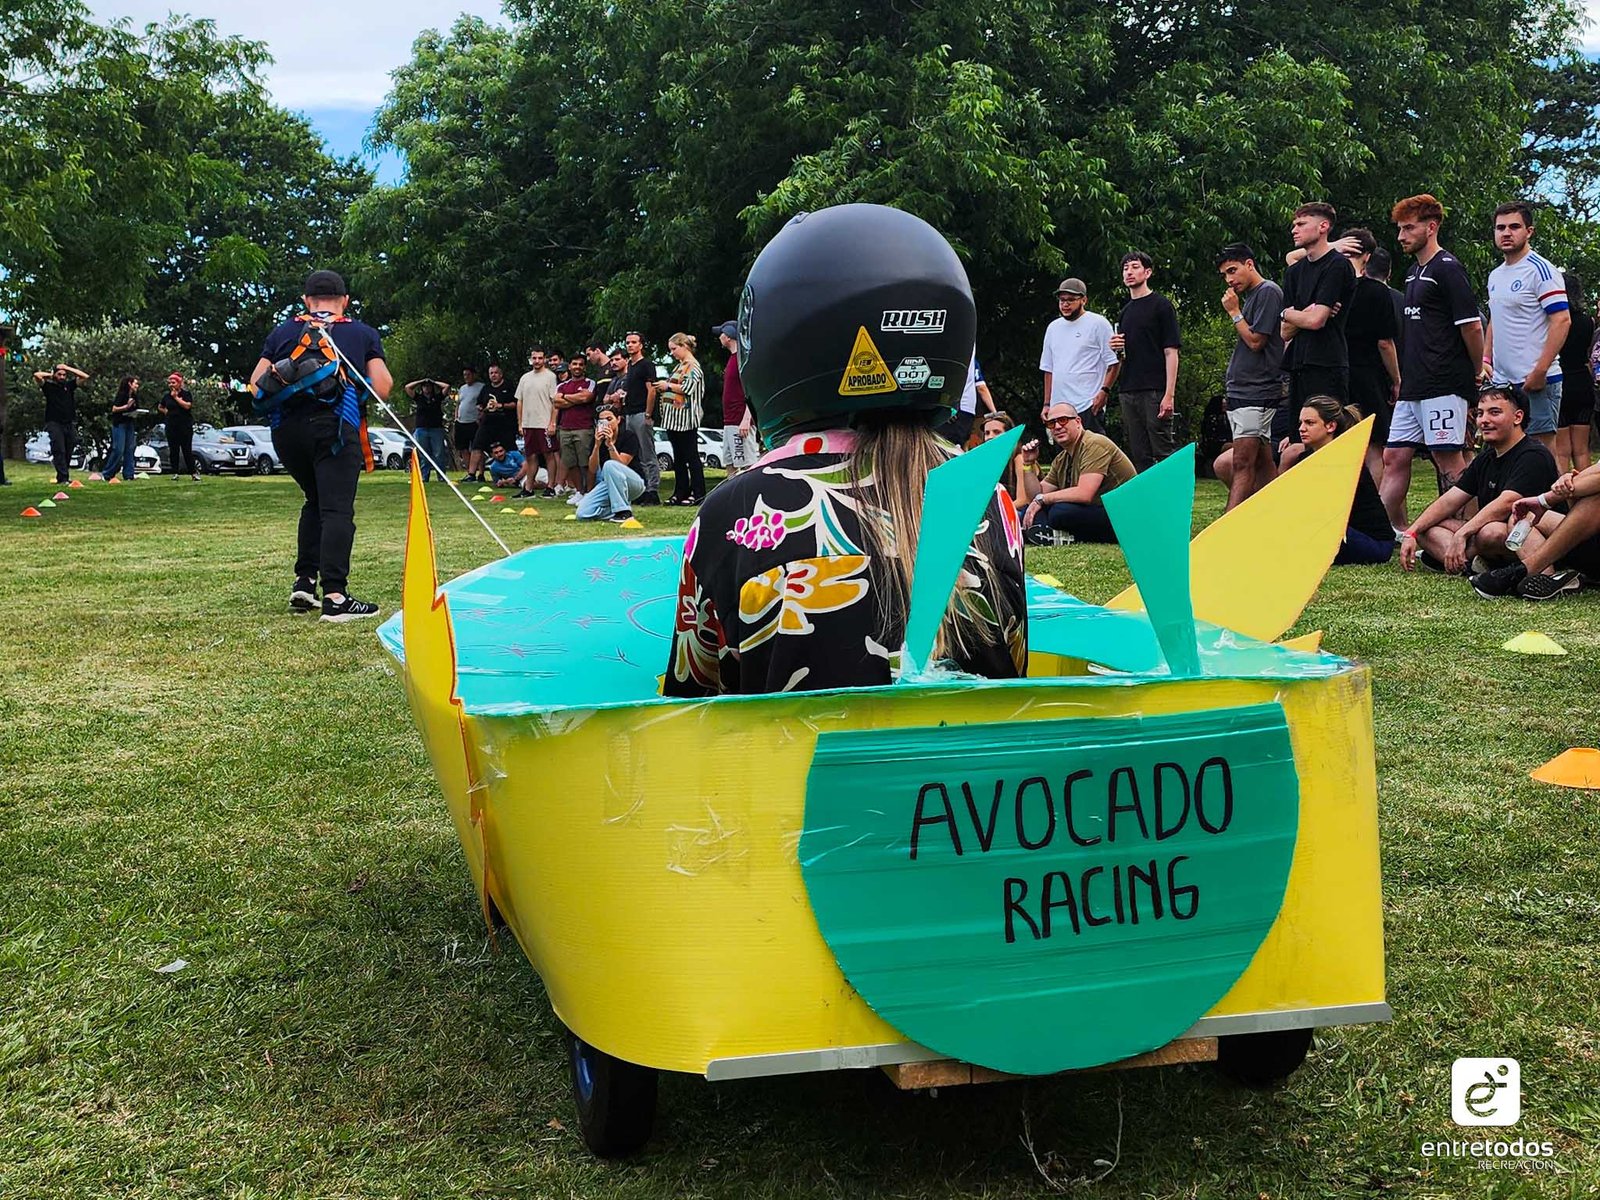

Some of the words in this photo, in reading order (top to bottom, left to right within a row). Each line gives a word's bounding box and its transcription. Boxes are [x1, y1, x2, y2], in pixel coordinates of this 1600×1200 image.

[882, 311, 946, 327] RUSH
[848, 373, 887, 387] APROBADO
[897, 370, 928, 379] DOT
[1430, 409, 1454, 430] 22
[733, 433, 745, 461] VENICE
[910, 757, 1233, 860] AVOCADO
[1003, 856, 1200, 943] RACING
